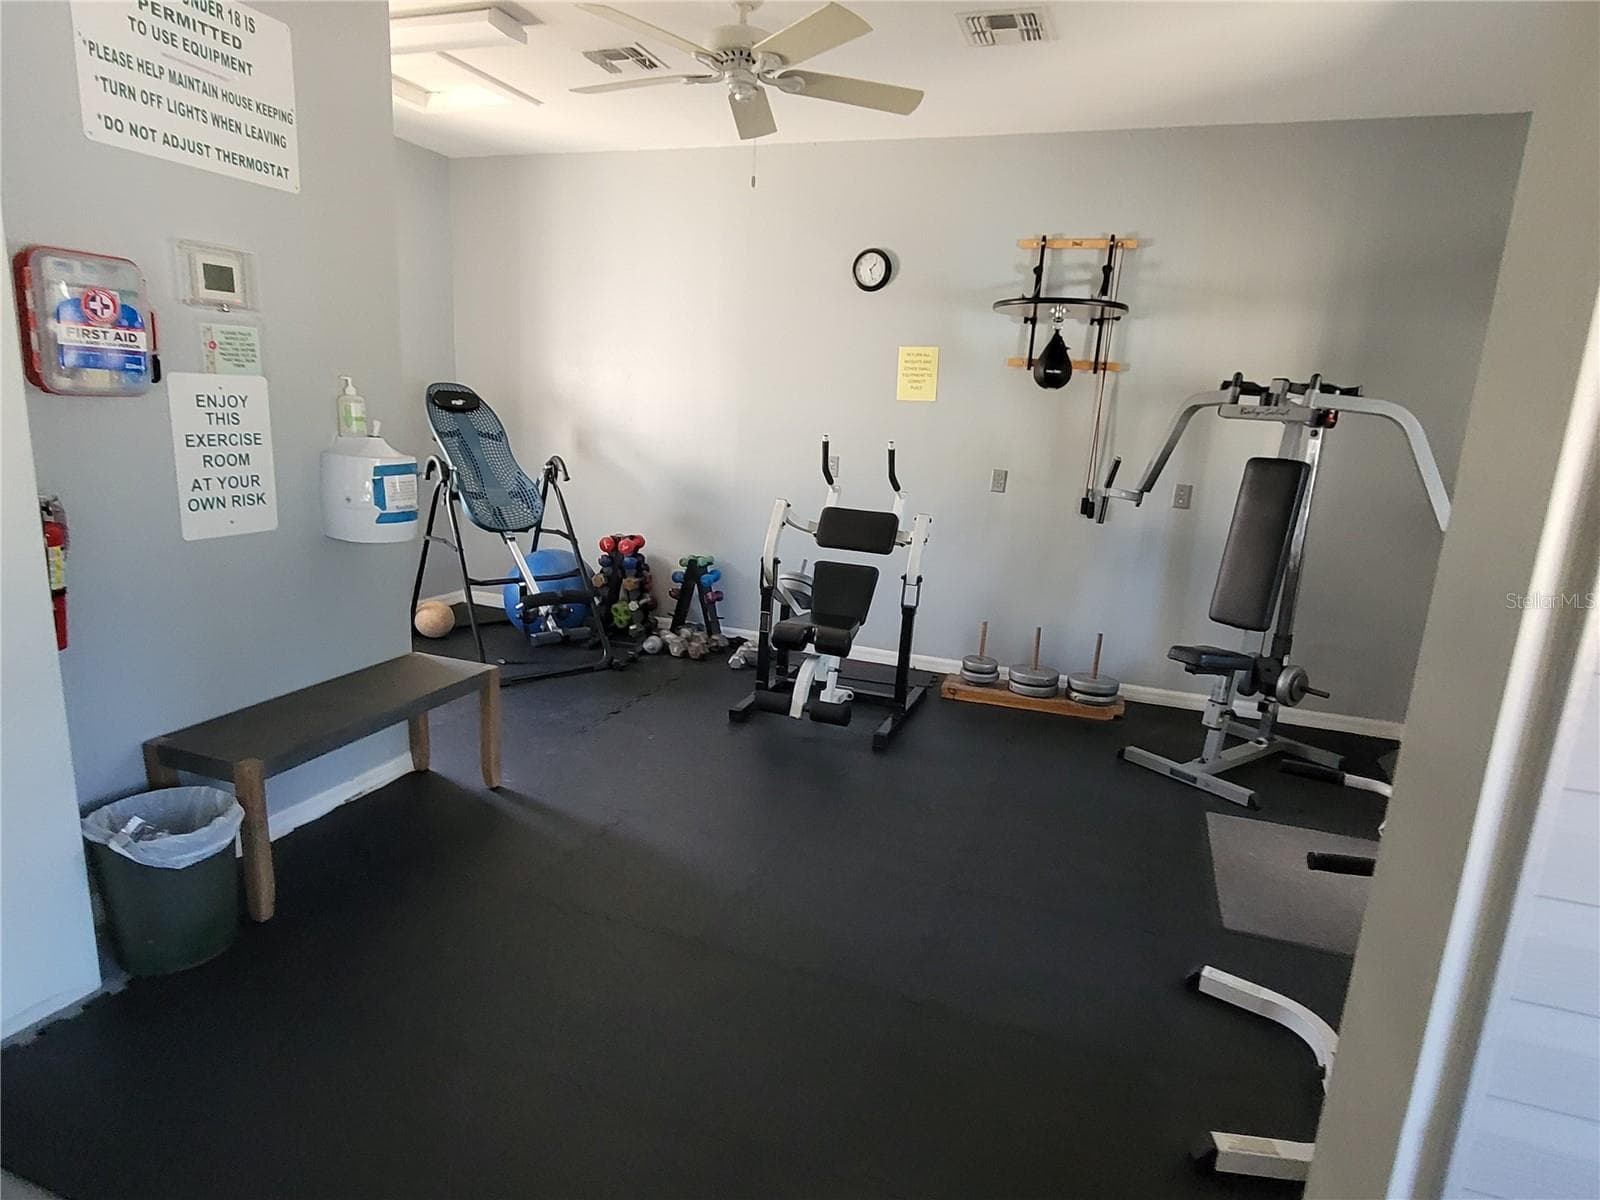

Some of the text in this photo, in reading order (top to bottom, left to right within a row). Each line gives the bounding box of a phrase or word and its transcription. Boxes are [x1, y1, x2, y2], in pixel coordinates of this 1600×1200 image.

[138, 0, 242, 49] PERMITTED
[228, 9, 241, 28] 18
[244, 15, 255, 34] IS
[128, 16, 253, 76] TO USE EQUIPMENT
[137, 59, 165, 80] HELP
[168, 69, 218, 99] MAINTAIN
[221, 90, 253, 111] HOUSE
[255, 101, 294, 125] KEEPING
[140, 89, 163, 109] OFF
[167, 98, 208, 124] LIGHTS
[211, 112, 242, 135] WHEN
[245, 125, 287, 149] LEAVING
[129, 123, 157, 143] NOT
[162, 133, 211, 158] ADJUST
[215, 147, 289, 180] THERMOSTAT
[66, 326, 109, 340] FIRST
[113, 332, 138, 343] AID
[195, 394, 248, 408] ENJOY
[205, 412, 240, 425] THIS
[185, 433, 262, 448] EXERCISE
[202, 453, 250, 468] ROOM
[191, 474, 261, 492] AT YOUR
[187, 492, 267, 512] OWN RISK
